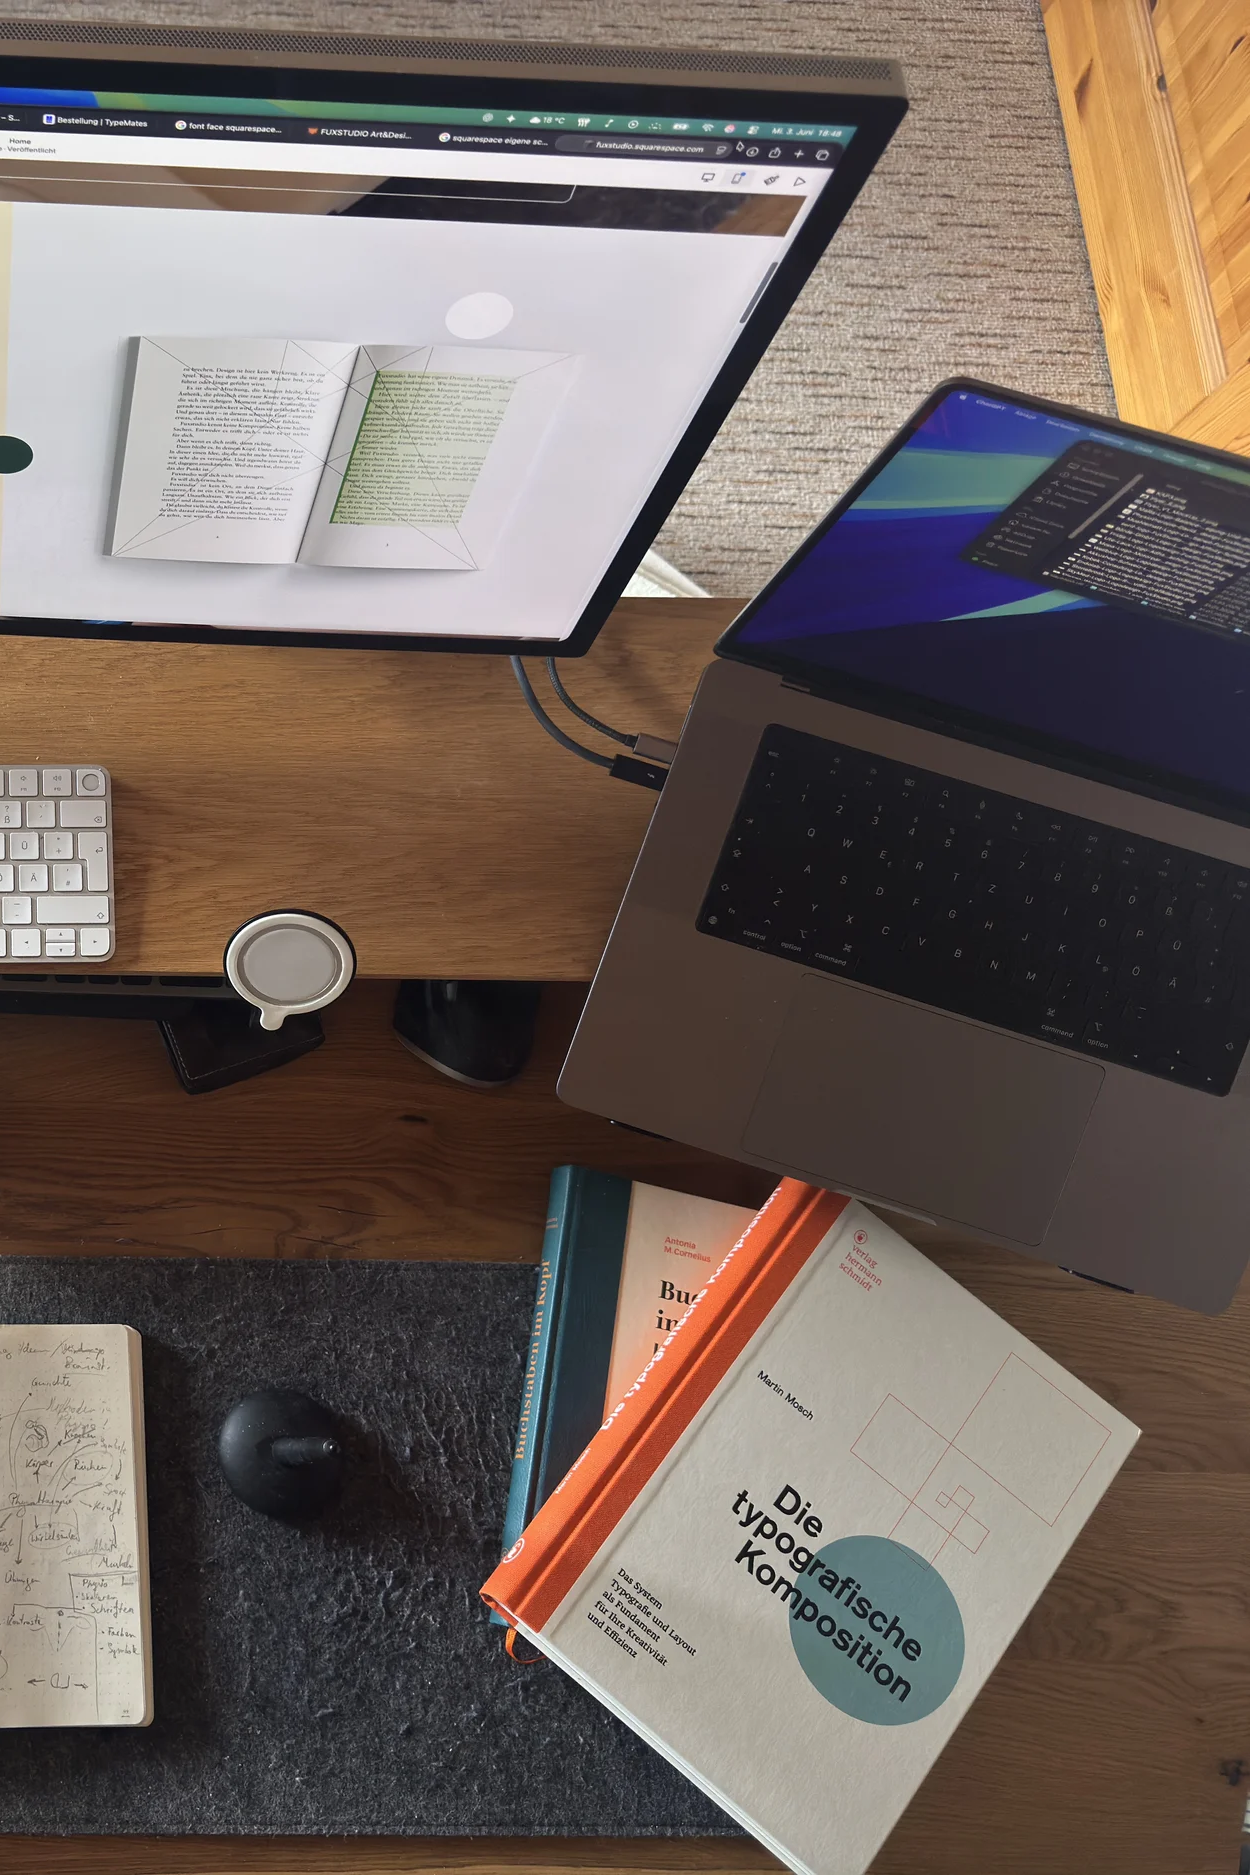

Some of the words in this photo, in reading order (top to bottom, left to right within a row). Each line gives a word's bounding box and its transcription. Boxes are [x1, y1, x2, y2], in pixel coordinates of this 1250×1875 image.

[57, 117, 98, 126] Bestellung
[105, 119, 148, 128] TypeMates
[189, 122, 205, 130] font
[206, 123, 224, 131] face
[320, 128, 369, 137] FUXSTUDIO
[7, 146, 56, 154] Veröffentlicht
[452, 134, 502, 145] squarespace
[504, 137, 531, 146] eigene
[596, 141, 704, 153] fuxstudio.squarespace.com
[742, 929, 767, 942] control
[781, 941, 802, 952] option
[815, 951, 847, 966] command
[664, 1236, 696, 1249] Antonia
[853, 1244, 879, 1269] verlag
[839, 1262, 874, 1292] schmidt
[845, 1252, 883, 1286] hermann
[515, 1342, 540, 1459] Buchstaben
[532, 1310, 544, 1337] im
[757, 1369, 784, 1397] Martin
[785, 1392, 815, 1421] Mosch
[773, 1484, 823, 1538] Die
[617, 1567, 634, 1585] Das
[633, 1582, 663, 1610] System
[731, 1489, 922, 1662] typografische
[602, 1590, 616, 1604] als
[615, 1600, 661, 1643] Fundament
[611, 1579, 652, 1618] Typografie
[652, 1615, 670, 1633] und
[668, 1629, 697, 1657] Layout
[734, 1539, 912, 1703] Komposition
[587, 1612, 605, 1630] und
[603, 1627, 638, 1659] Effizienz
[594, 1600, 609, 1616] für
[608, 1611, 626, 1630] Ihre
[625, 1627, 668, 1667] Kreativität
